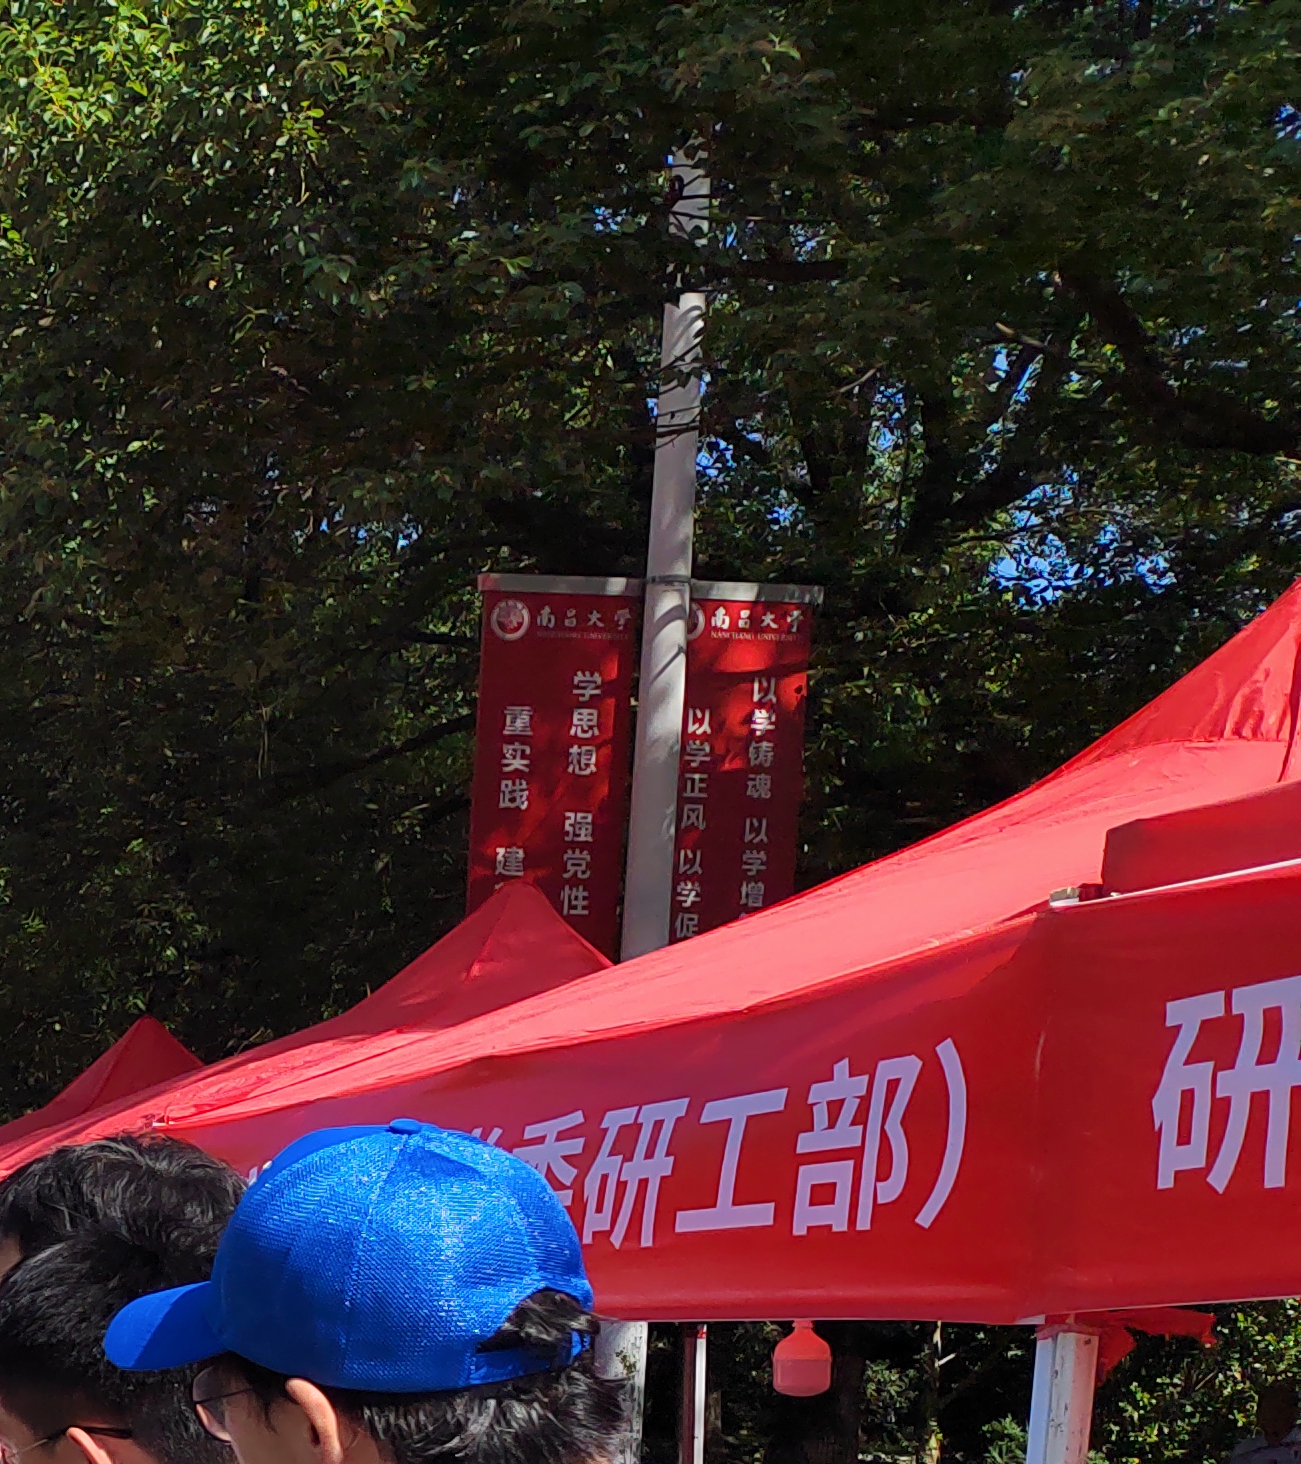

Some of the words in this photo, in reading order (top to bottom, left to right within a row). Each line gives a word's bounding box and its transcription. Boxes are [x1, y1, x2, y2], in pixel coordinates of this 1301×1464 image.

[537, 605, 631, 630] 南昌大学
[711, 606, 803, 632] 南昌大学
[499, 705, 534, 810] 重实践
[567, 671, 602, 775] 学思想
[681, 707, 711, 830] 以学正风
[747, 677, 776, 799] 以学铸魂
[494, 847, 525, 889] 建
[560, 811, 593, 916] 强党性
[739, 817, 768, 919] 以学增
